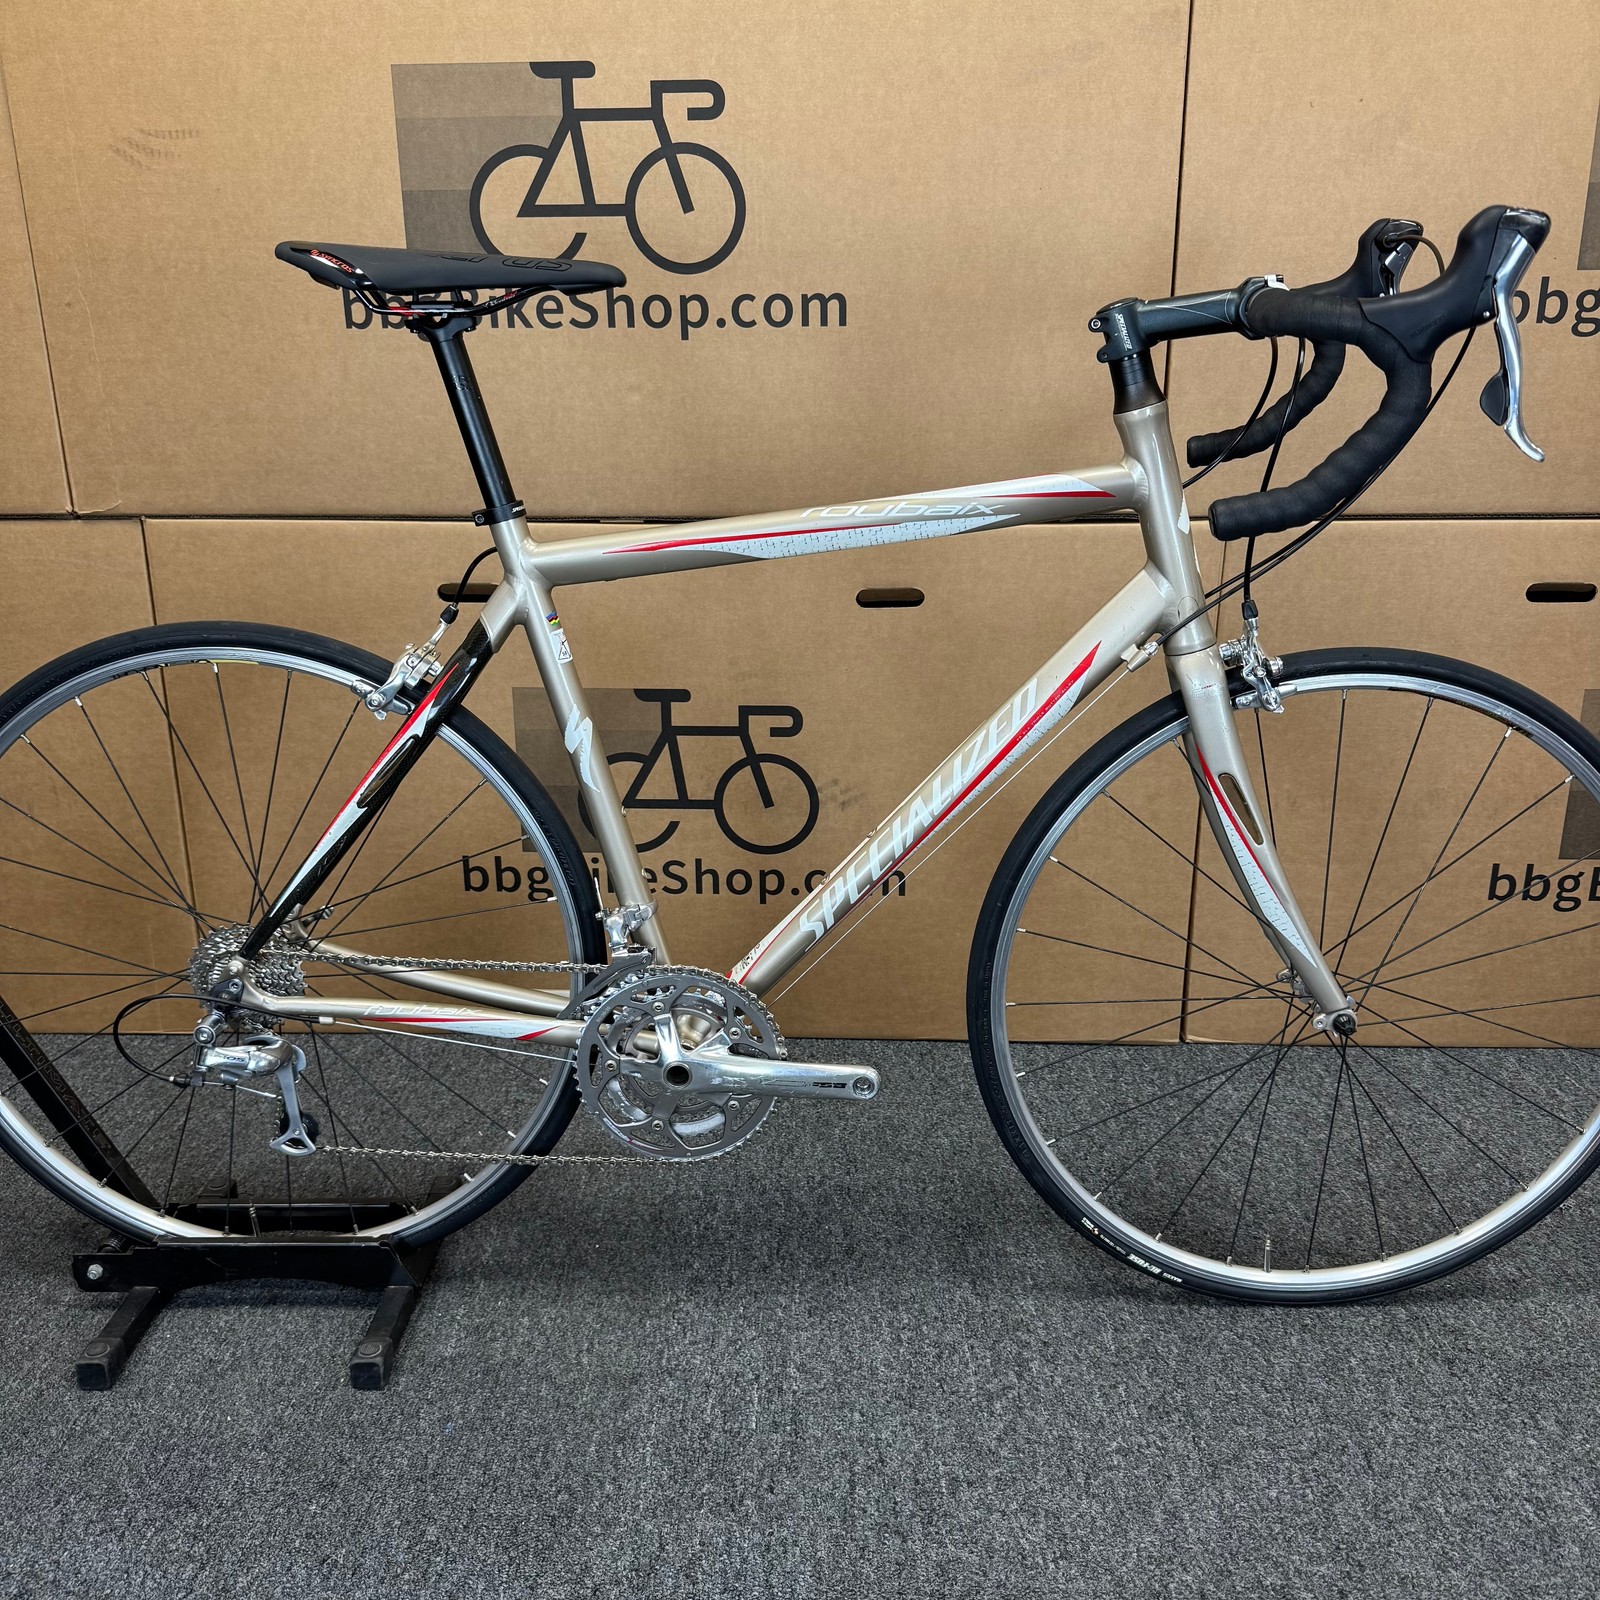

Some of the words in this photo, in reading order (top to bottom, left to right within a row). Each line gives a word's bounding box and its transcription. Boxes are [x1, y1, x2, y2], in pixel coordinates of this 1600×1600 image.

[800, 501, 1005, 518] roubaix
[799, 677, 1038, 952] SPECIALIZED
[363, 1004, 482, 1016] roubaix
